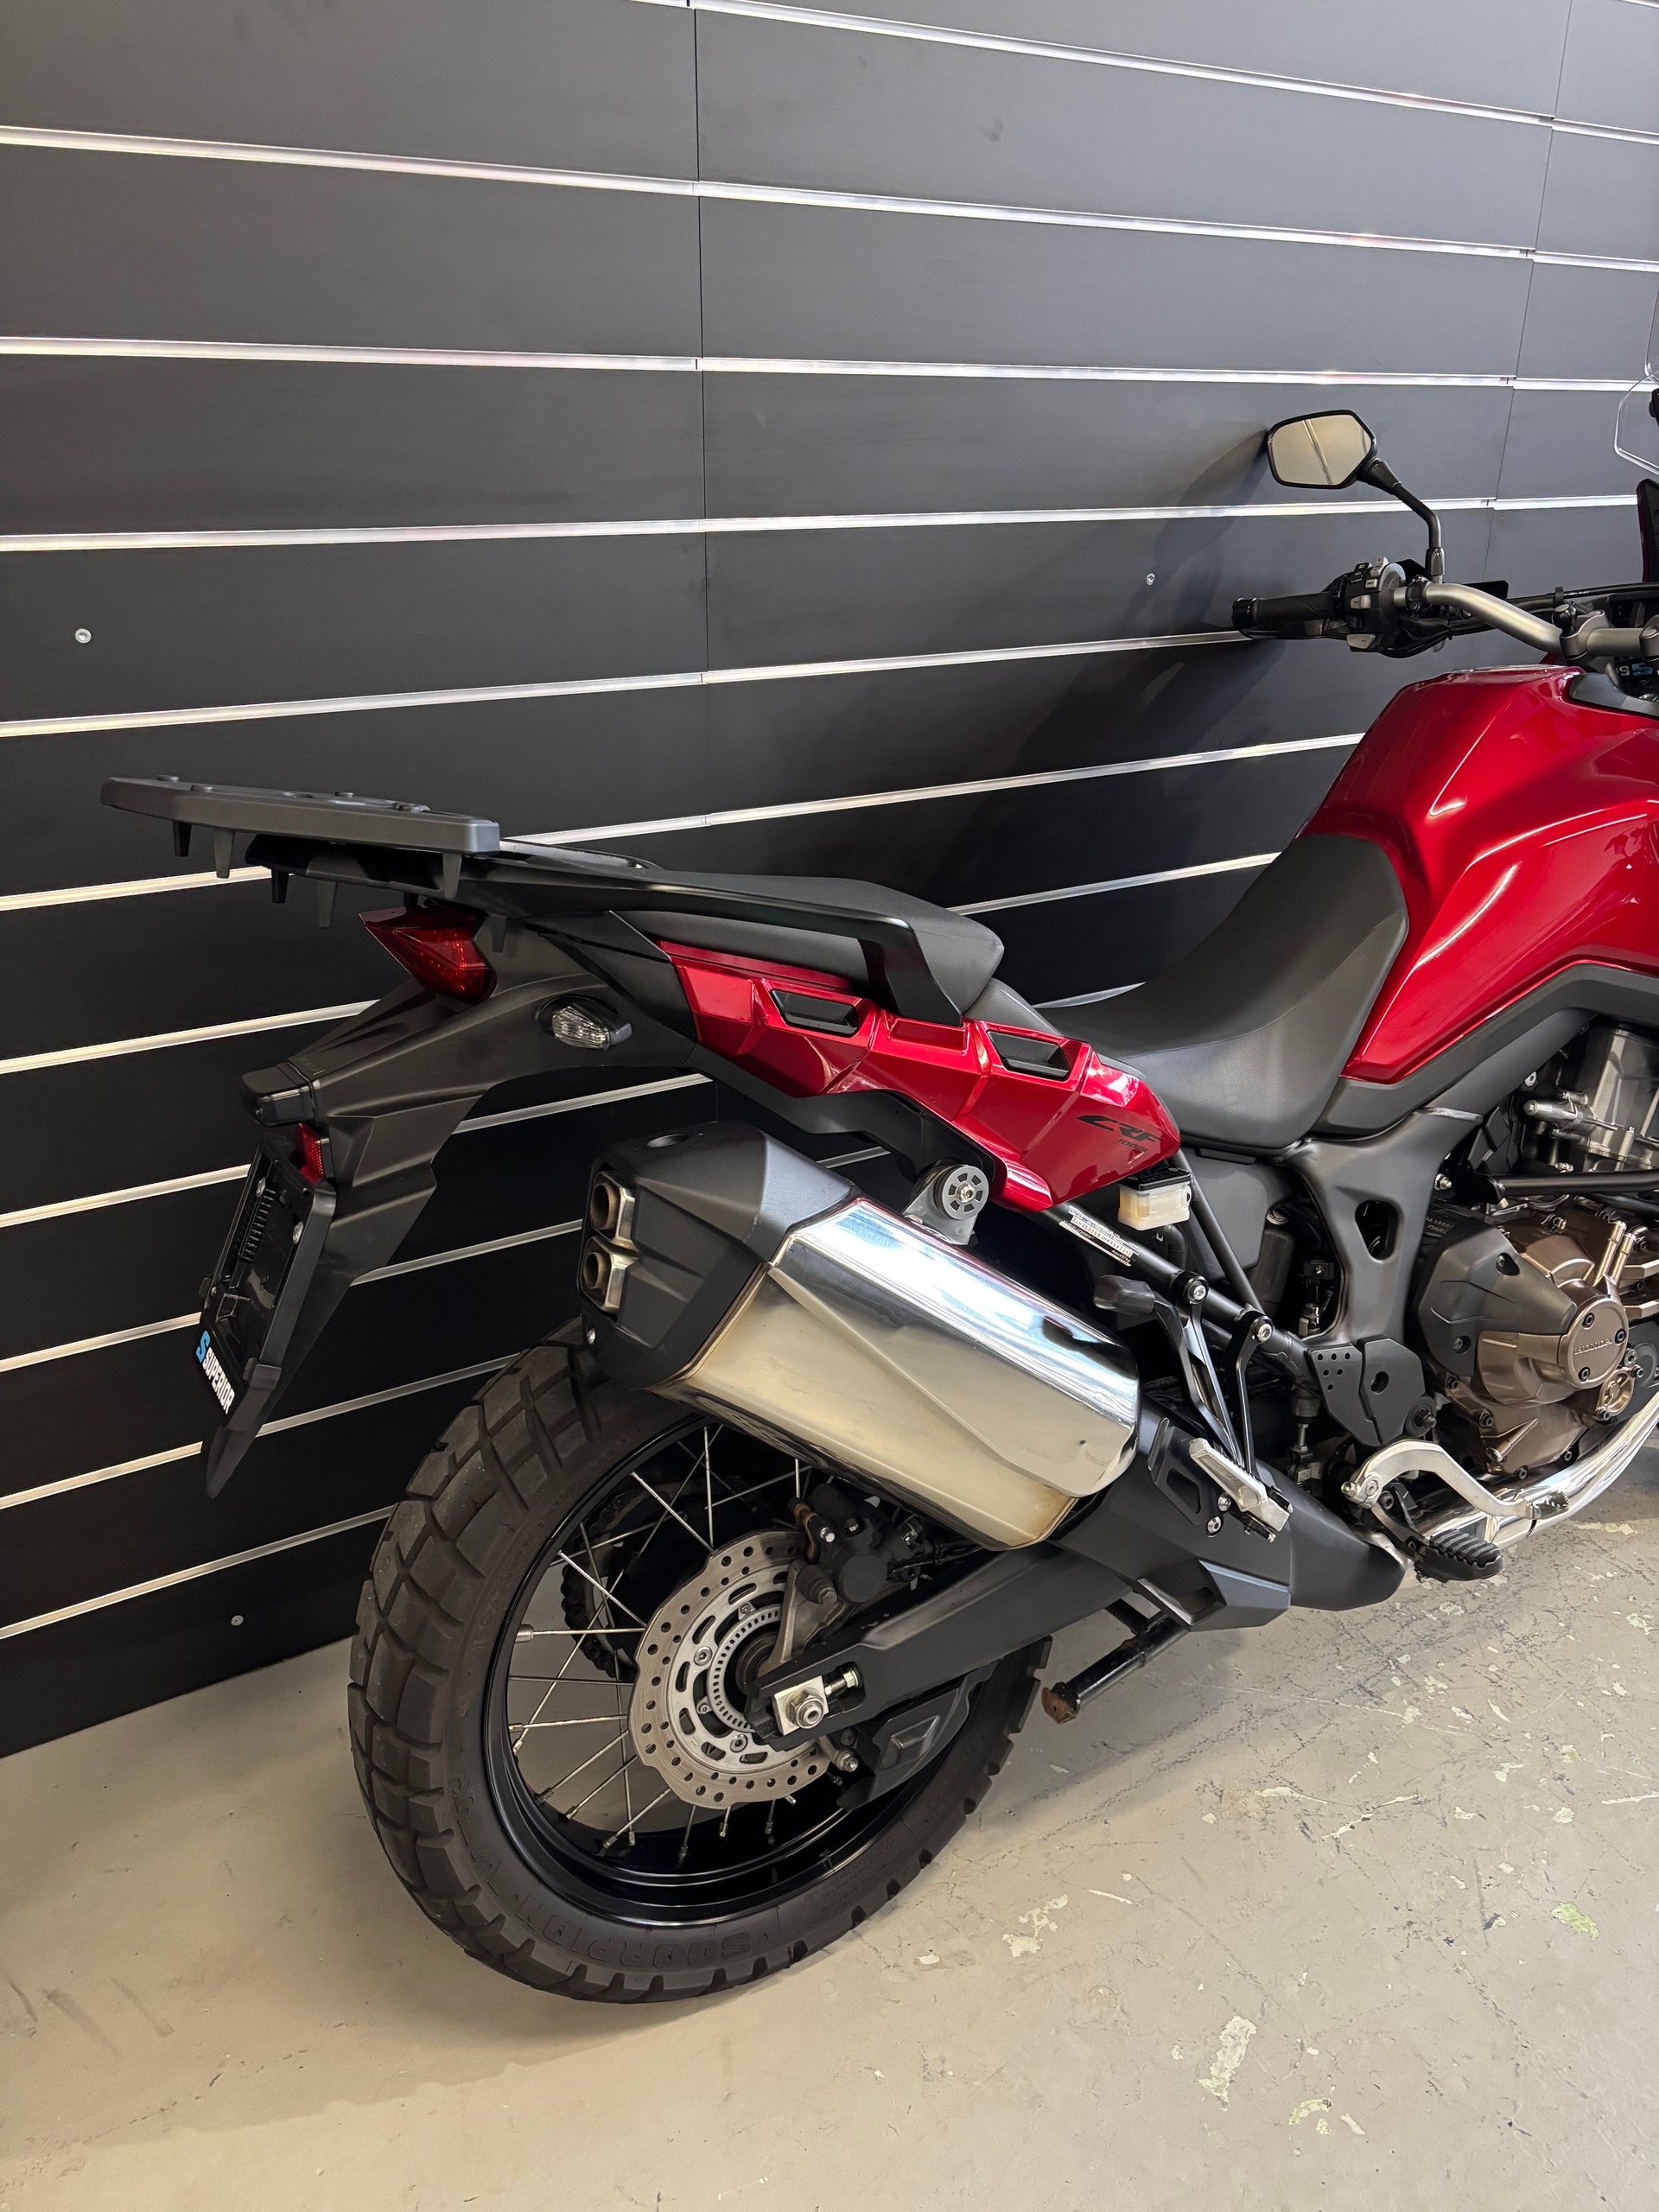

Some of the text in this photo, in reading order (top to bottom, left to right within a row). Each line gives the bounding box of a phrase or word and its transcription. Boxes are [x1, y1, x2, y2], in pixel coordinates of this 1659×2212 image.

[1077, 1116, 1161, 1142] CRF
[1574, 1338, 1612, 1356] HONDA
[201, 1346, 236, 1415] SUPERIOR
